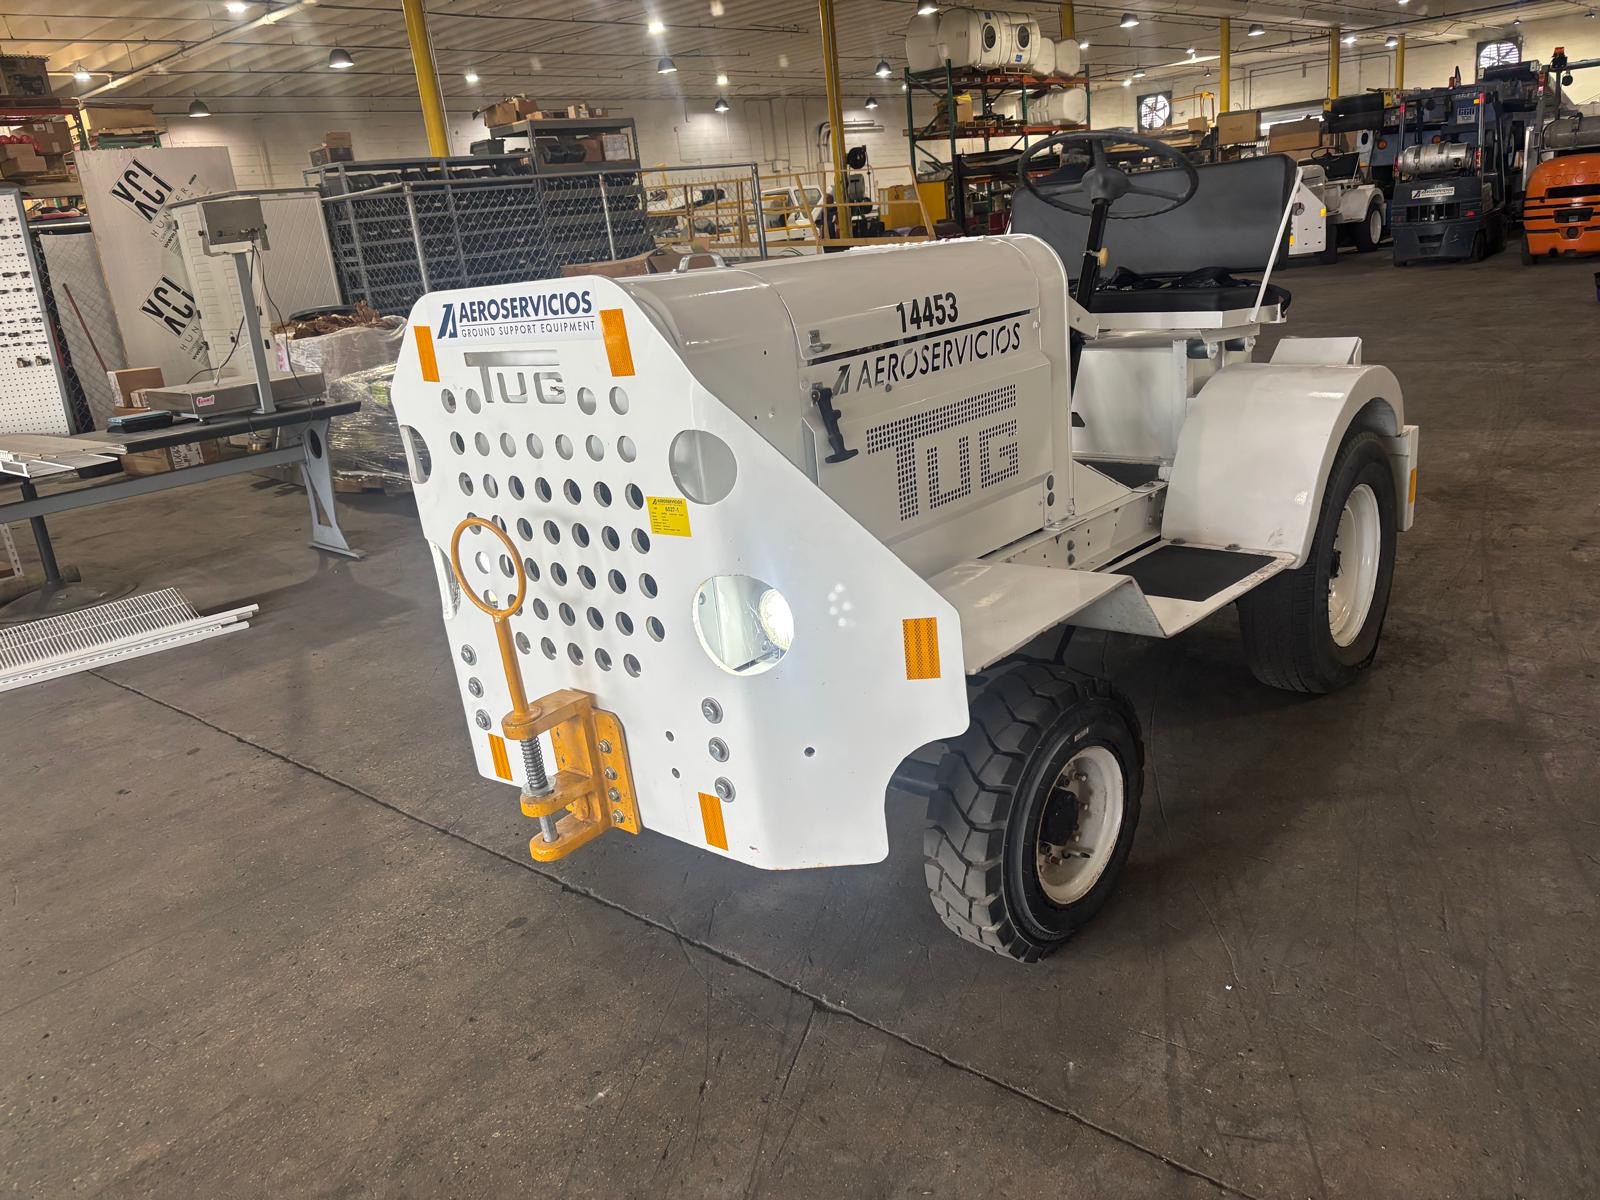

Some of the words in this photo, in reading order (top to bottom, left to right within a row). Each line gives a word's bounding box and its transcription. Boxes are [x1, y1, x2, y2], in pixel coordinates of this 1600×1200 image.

[459, 291, 592, 323] AEROSERVICIOS
[461, 327, 496, 338] GROUND
[499, 324, 537, 336] SUPPORT
[540, 320, 595, 333] EQUIPMENT
[896, 292, 959, 333] 14453
[463, 349, 567, 404] TUG
[856, 322, 1021, 393] AEROSERVICIOS
[866, 383, 1019, 521] TUG
